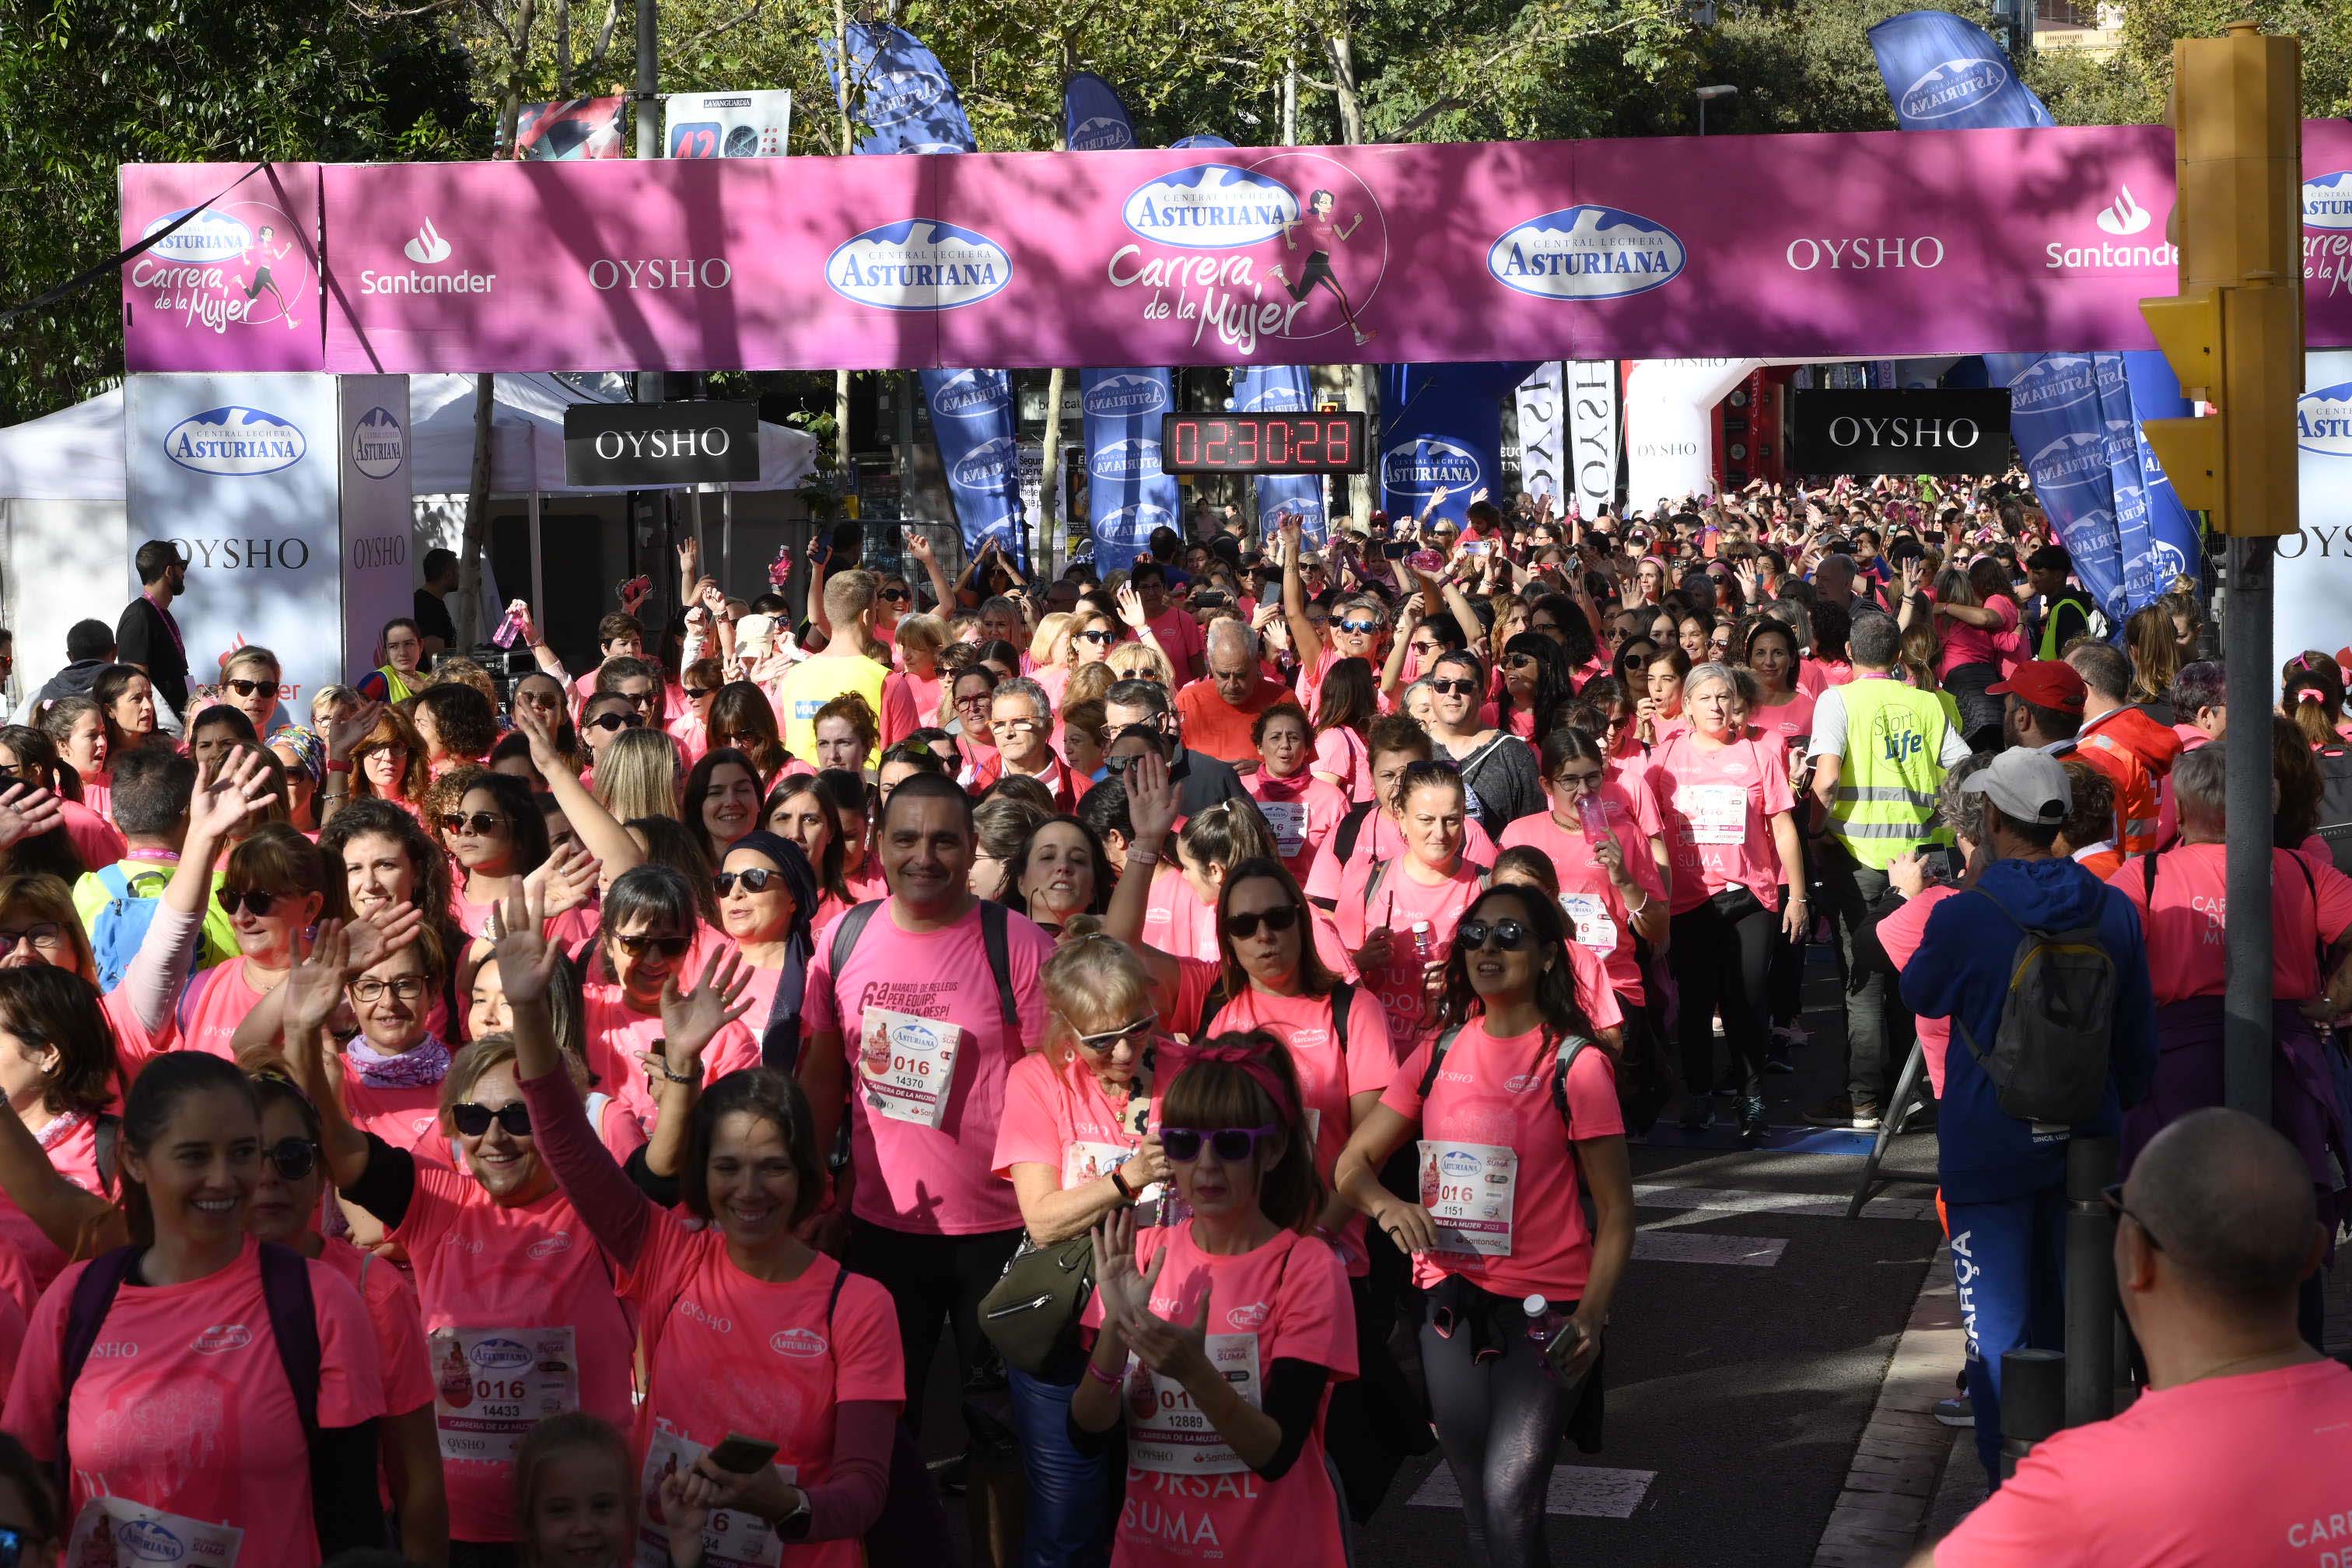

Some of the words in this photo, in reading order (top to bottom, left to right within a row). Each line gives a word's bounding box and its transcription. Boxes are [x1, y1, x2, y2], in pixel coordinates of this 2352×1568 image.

[1137, 196, 1286, 227] ASTURIANA
[1533, 237, 1594, 249] CENTRAL
[1601, 236, 1664, 247] LECHERA
[869, 250, 928, 260] CENTRAL
[932, 250, 992, 259] LECHERA
[1503, 242, 1671, 276] ASTURIANA
[1786, 236, 1944, 271] OYSHO
[2046, 241, 2180, 269] Santande
[131, 259, 224, 289] Carrera
[588, 257, 731, 290] OYSHO
[839, 254, 998, 287] ASTURIANA
[1108, 244, 1255, 288] Carrera
[2318, 257, 2332, 279] la
[361, 269, 496, 294] Santander
[155, 290, 172, 310] de
[175, 289, 187, 310] la
[185, 285, 258, 334] Mujer
[1144, 290, 1171, 320] de
[1176, 289, 1196, 320] la
[1192, 282, 1308, 355] Mujer
[247, 429, 292, 438] LECHERA
[1829, 416, 1979, 449] OYSHO
[175, 432, 297, 458] ASTURIANA
[355, 436, 401, 461] ASTURIANA
[596, 427, 730, 460] OYSHO
[1176, 422, 1349, 464] 02:30:28
[1638, 442, 1696, 457] OYSHO
[1020, 468, 1032, 478] que
[1385, 462, 1473, 485] ASTURIANA
[2274, 525, 2352, 559] OYS
[353, 534, 405, 571] OYSHO
[1885, 730, 1923, 763] life
[1678, 852, 1724, 867] SUMA
[891, 982, 919, 994] MARATÓ
[920, 983, 928, 992] DE
[929, 982, 958, 992] RELLEUS
[885, 994, 905, 1006] PER
[906, 993, 937, 1006] EQUIPS
[924, 1003, 951, 1018] DESPÍ
[896, 1031, 935, 1047] ASTURIANA
[894, 1055, 930, 1076] 016
[895, 1076, 924, 1089] 14370
[1437, 1069, 1474, 1083] YSHO
[868, 1082, 894, 1094] CARRERA
[915, 1093, 936, 1102] MUJER
[2032, 1135, 2054, 1143] SINCE
[1443, 1160, 1478, 1172] ASTURIANA
[1441, 1185, 1474, 1202] 016
[1444, 1206, 1463, 1216] 1151
[1465, 1237, 1501, 1247] Santander
[775, 1338, 824, 1353] ASTURIANA
[475, 1347, 527, 1362] ASTURIANA
[1216, 1353, 1247, 1362] SUMA
[477, 1380, 526, 1399] 016
[1160, 1390, 1191, 1409] 01
[482, 1404, 520, 1418] 14433
[450, 1419, 484, 1430] CARRERA
[1167, 1415, 1203, 1428] 12889
[1138, 1430, 1172, 1440] CARRERA
[447, 1437, 485, 1451] OYSHO
[1137, 1449, 1174, 1462] OYSHO
[1125, 1496, 1220, 1546] SUMA
[1202, 1550, 1223, 1559] 2023
